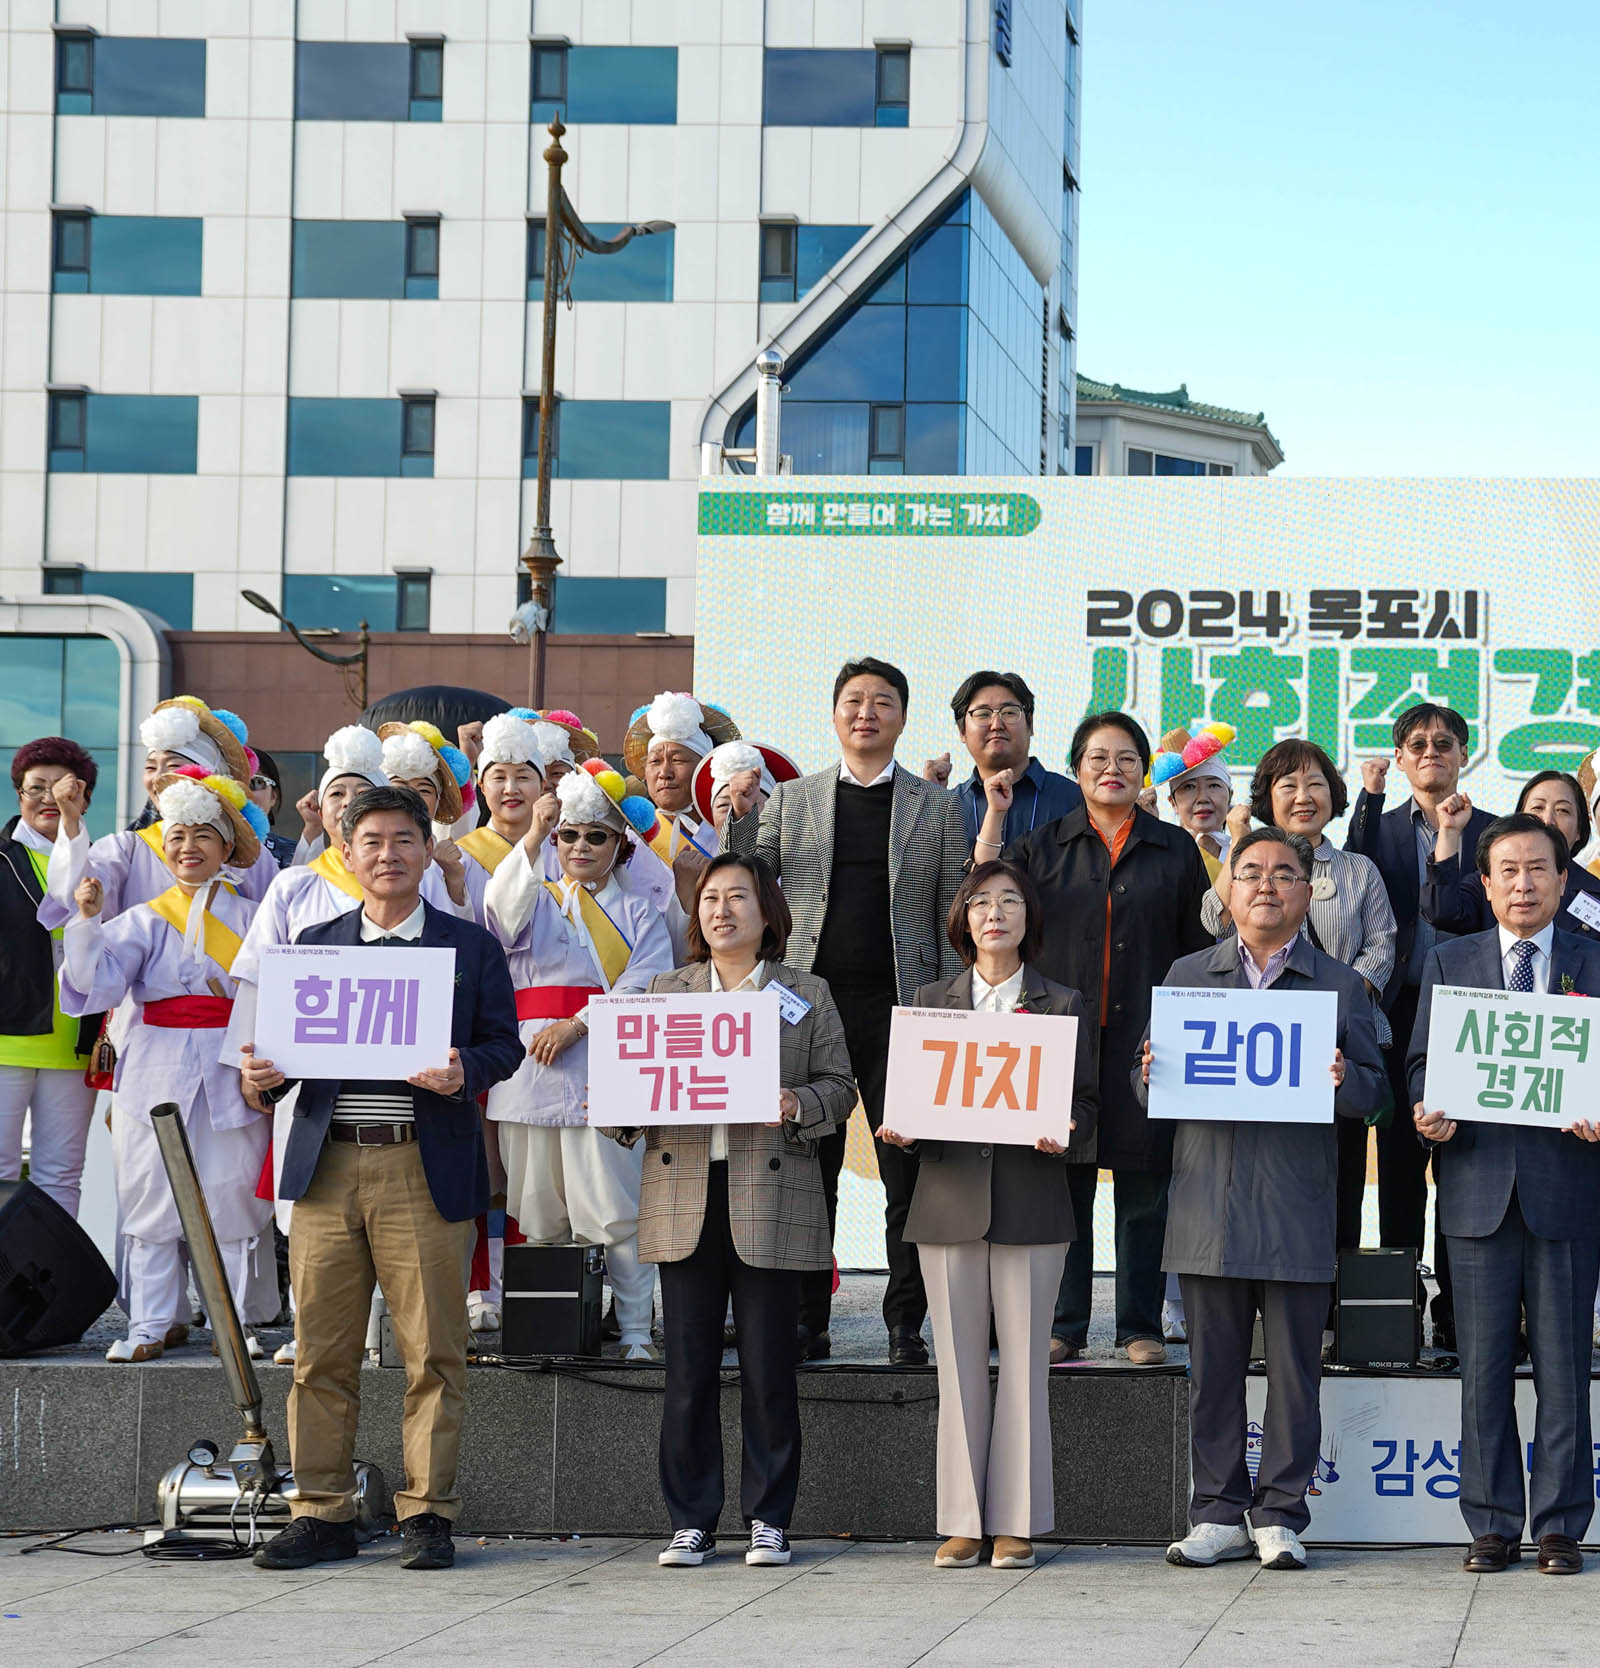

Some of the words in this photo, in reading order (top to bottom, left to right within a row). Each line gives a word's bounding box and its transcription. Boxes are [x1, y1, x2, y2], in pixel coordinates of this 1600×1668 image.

[766, 502, 816, 526] 함께
[823, 502, 896, 526] 만들어
[904, 502, 952, 526] 가는
[959, 502, 1009, 526] 가치
[1086, 590, 1289, 638] 2024
[1308, 589, 1479, 639] 목포시
[294, 975, 420, 1045] 함께
[617, 1011, 752, 1060] 만들어
[1455, 1008, 1591, 1063] 사회적
[922, 1039, 1042, 1111] 가치
[1183, 1020, 1302, 1088] 같이
[639, 1065, 729, 1112] 가는
[1476, 1062, 1565, 1113] 경제
